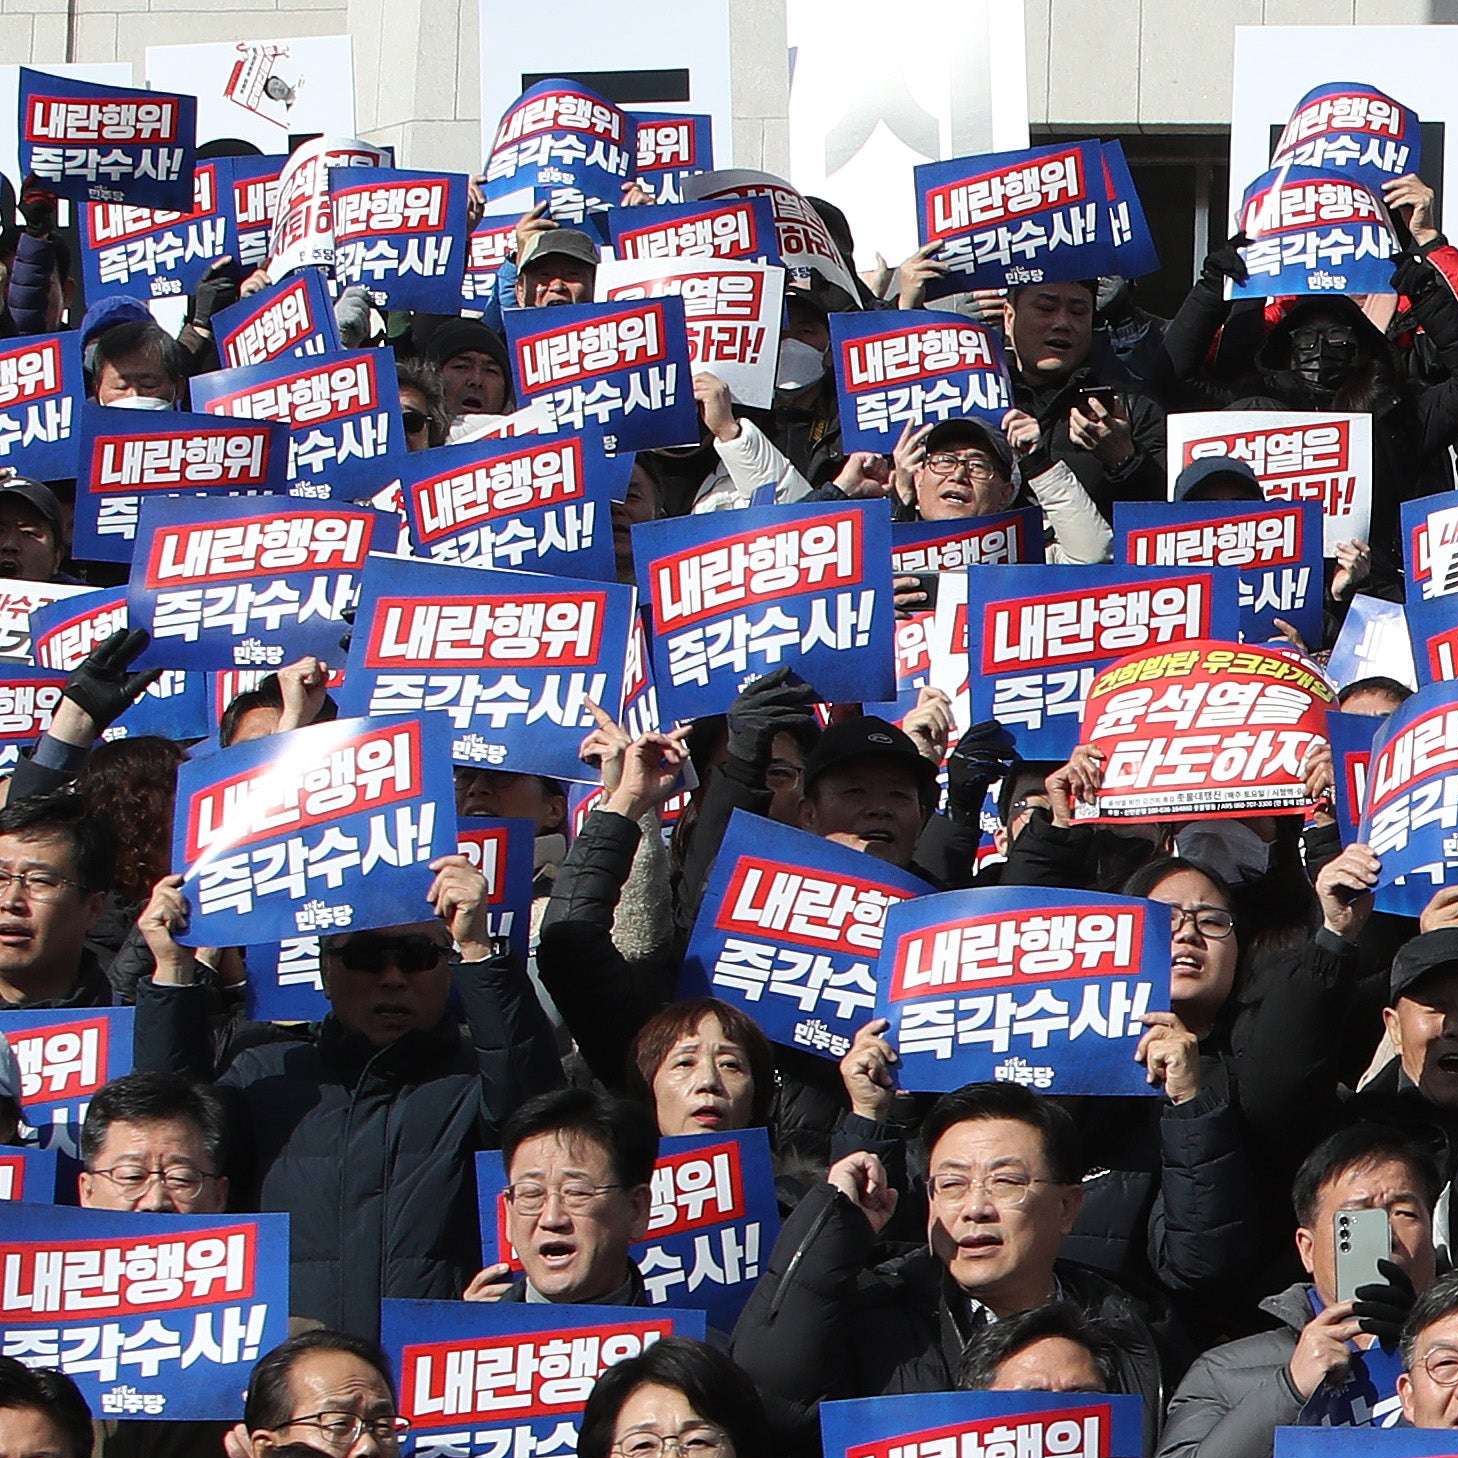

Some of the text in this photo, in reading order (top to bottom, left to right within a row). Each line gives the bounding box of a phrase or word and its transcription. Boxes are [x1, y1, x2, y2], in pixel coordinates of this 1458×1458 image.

[32, 102, 170, 139] 내란행위
[30, 147, 183, 182] 즉각수사!
[486, 143, 630, 178] 즉각수사!
[935, 156, 1078, 231] 내란행위
[1248, 185, 1386, 236] 내란행위
[99, 217, 226, 282] 즉각수사!
[939, 202, 1096, 273] 즉각수사!
[1307, 273, 1347, 290] 민주당
[522, 316, 660, 389] 내란행위
[849, 328, 990, 385] 내란행위
[856, 378, 1010, 432] 즉각수사!
[100, 439, 264, 485] 내란행위
[419, 447, 578, 527] 내란행위
[156, 521, 363, 581] 내란행위
[659, 518, 854, 628] 내란행위
[153, 586, 360, 642] 즉각수사!
[380, 601, 596, 660] 내란행위
[666, 591, 873, 688] 즉각수사!
[994, 583, 1202, 665] 내란행위
[233, 647, 285, 665] 민주당
[369, 674, 607, 726] 즉각수사!
[1091, 681, 1312, 741] 윤석열을
[452, 739, 508, 765] 민주당
[196, 731, 413, 845] 내란행위
[199, 802, 436, 915] 즉각수사!
[296, 907, 353, 931] 민주당
[904, 912, 1133, 994] 내란행위
[899, 979, 1151, 1058] 즉각수사!
[994, 1065, 1054, 1088] 민주당
[4, 1233, 246, 1315] 내란행위
[102, 1392, 166, 1415] 민주당
